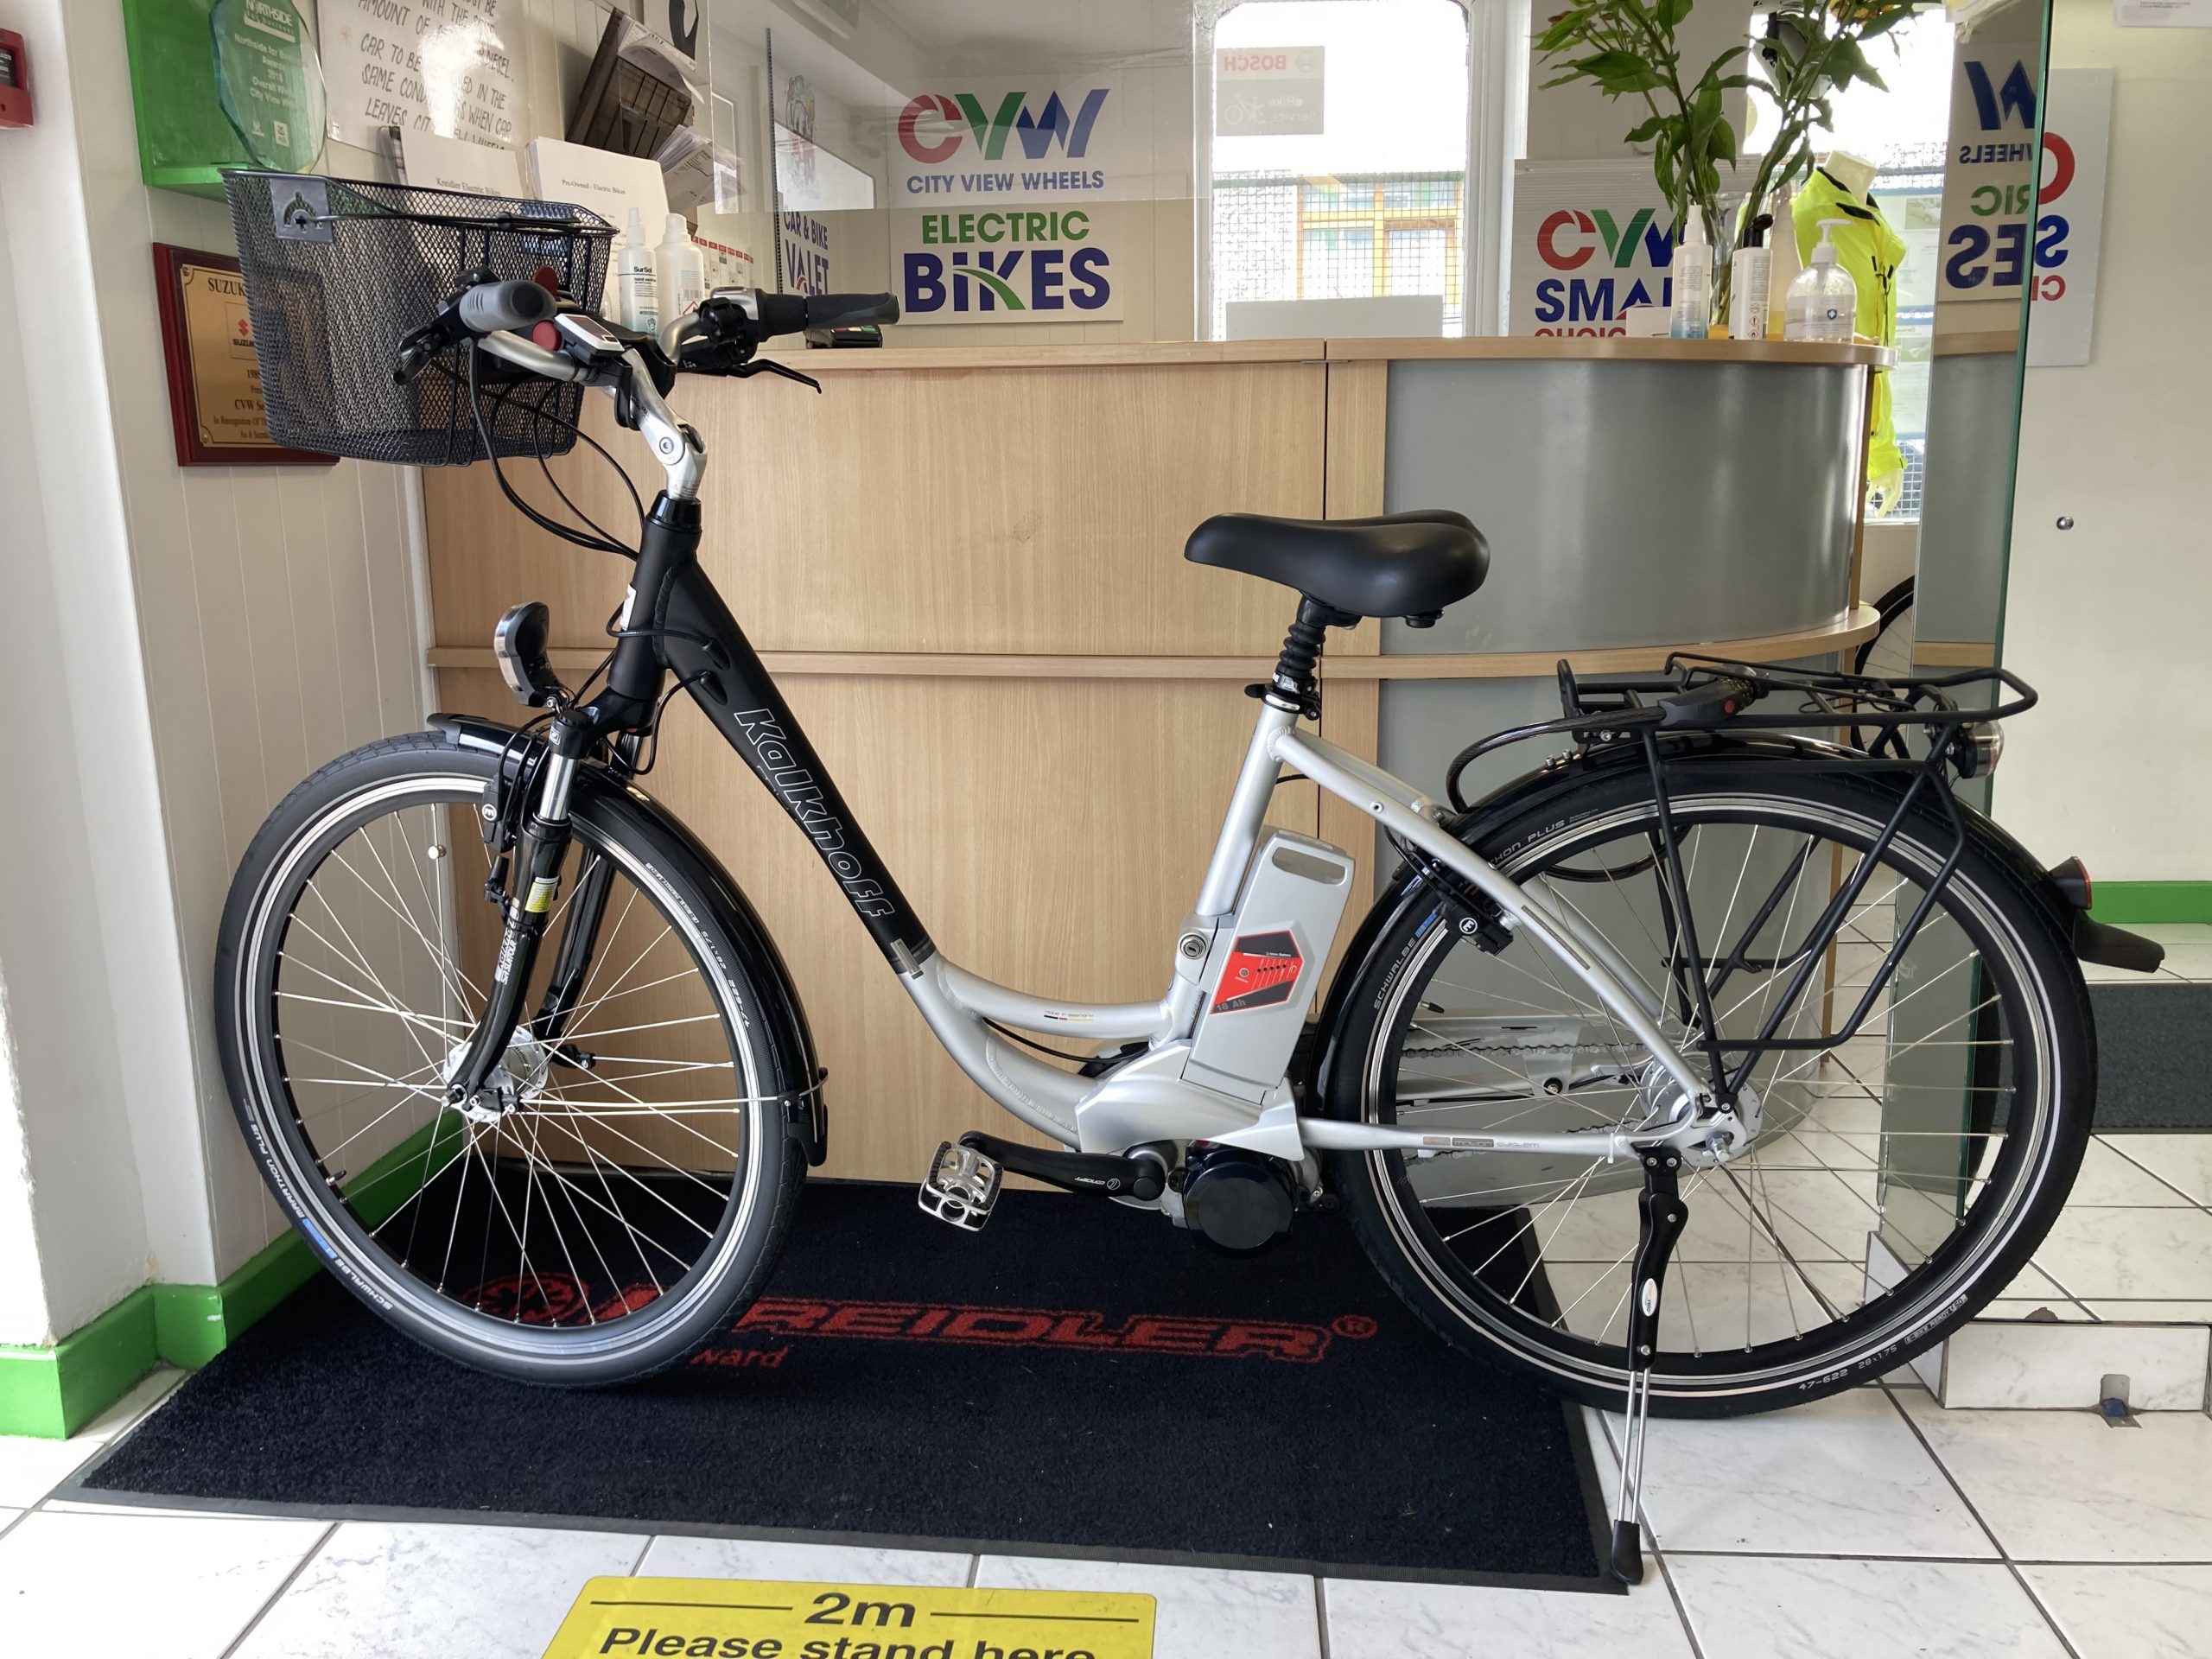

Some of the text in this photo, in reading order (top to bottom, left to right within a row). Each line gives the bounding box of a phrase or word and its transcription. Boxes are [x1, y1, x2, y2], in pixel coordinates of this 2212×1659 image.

[416, 15, 430, 35] OF
[360, 33, 422, 73] CAR TO BE
[362, 63, 395, 92] SAME
[365, 97, 408, 126] LEAVES
[490, 88, 506, 110] THE
[468, 105, 494, 133] WHEN
[907, 170, 1104, 194] CITY VIEW WHEELS
[784, 207, 828, 251] CAR & BIKE
[922, 210, 1090, 245] ELECTRIC
[785, 239, 830, 295] VALET
[208, 277, 246, 297] SUZUK
[234, 399, 254, 410] CVW
[734, 709, 895, 917] Kalkhoff
[1528, 819, 1566, 842] PLUS
[1373, 937, 1416, 1010] SCHWALBE
[1217, 998, 1247, 1012] 18 Ah
[250, 1123, 305, 1220] MARATHON PLUS
[335, 1258, 394, 1311] SCHWALBE
[1798, 1369, 1850, 1391] 47-622
[804, 1592, 916, 1628] 2m
[599, 1628, 1096, 1659] Please stand here
